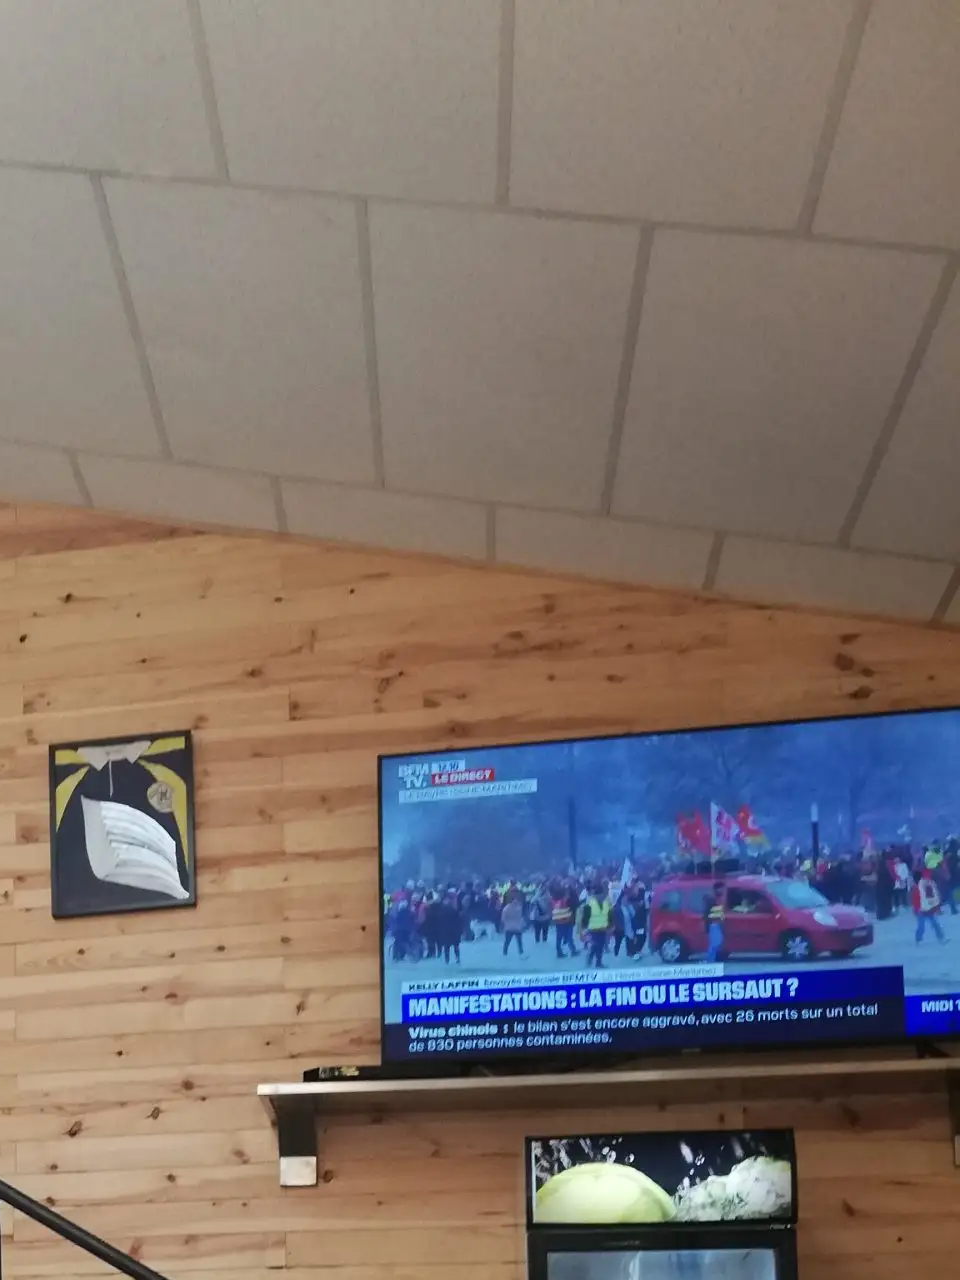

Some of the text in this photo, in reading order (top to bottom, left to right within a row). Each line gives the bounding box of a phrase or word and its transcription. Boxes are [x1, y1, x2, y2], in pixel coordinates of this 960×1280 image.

[408, 977, 800, 1018] MANIFESTATIONS : LA FIN OU LE SURSAUT ?
[921, 999, 954, 1013] MIDI
[408, 1024, 446, 1039] Virus
[447, 1021, 498, 1037] chinois
[513, 1020, 525, 1034] le
[527, 1019, 558, 1033] bilan
[560, 1017, 592, 1031] s'est
[594, 1015, 640, 1030] encore
[701, 1012, 733, 1025] avec
[735, 1009, 755, 1023] 26
[757, 1007, 798, 1022] morts
[801, 1006, 823, 1020] sur
[826, 1006, 843, 1019] un
[846, 1002, 878, 1017] total
[408, 1039, 425, 1053] de
[456, 1035, 524, 1053] personnes
